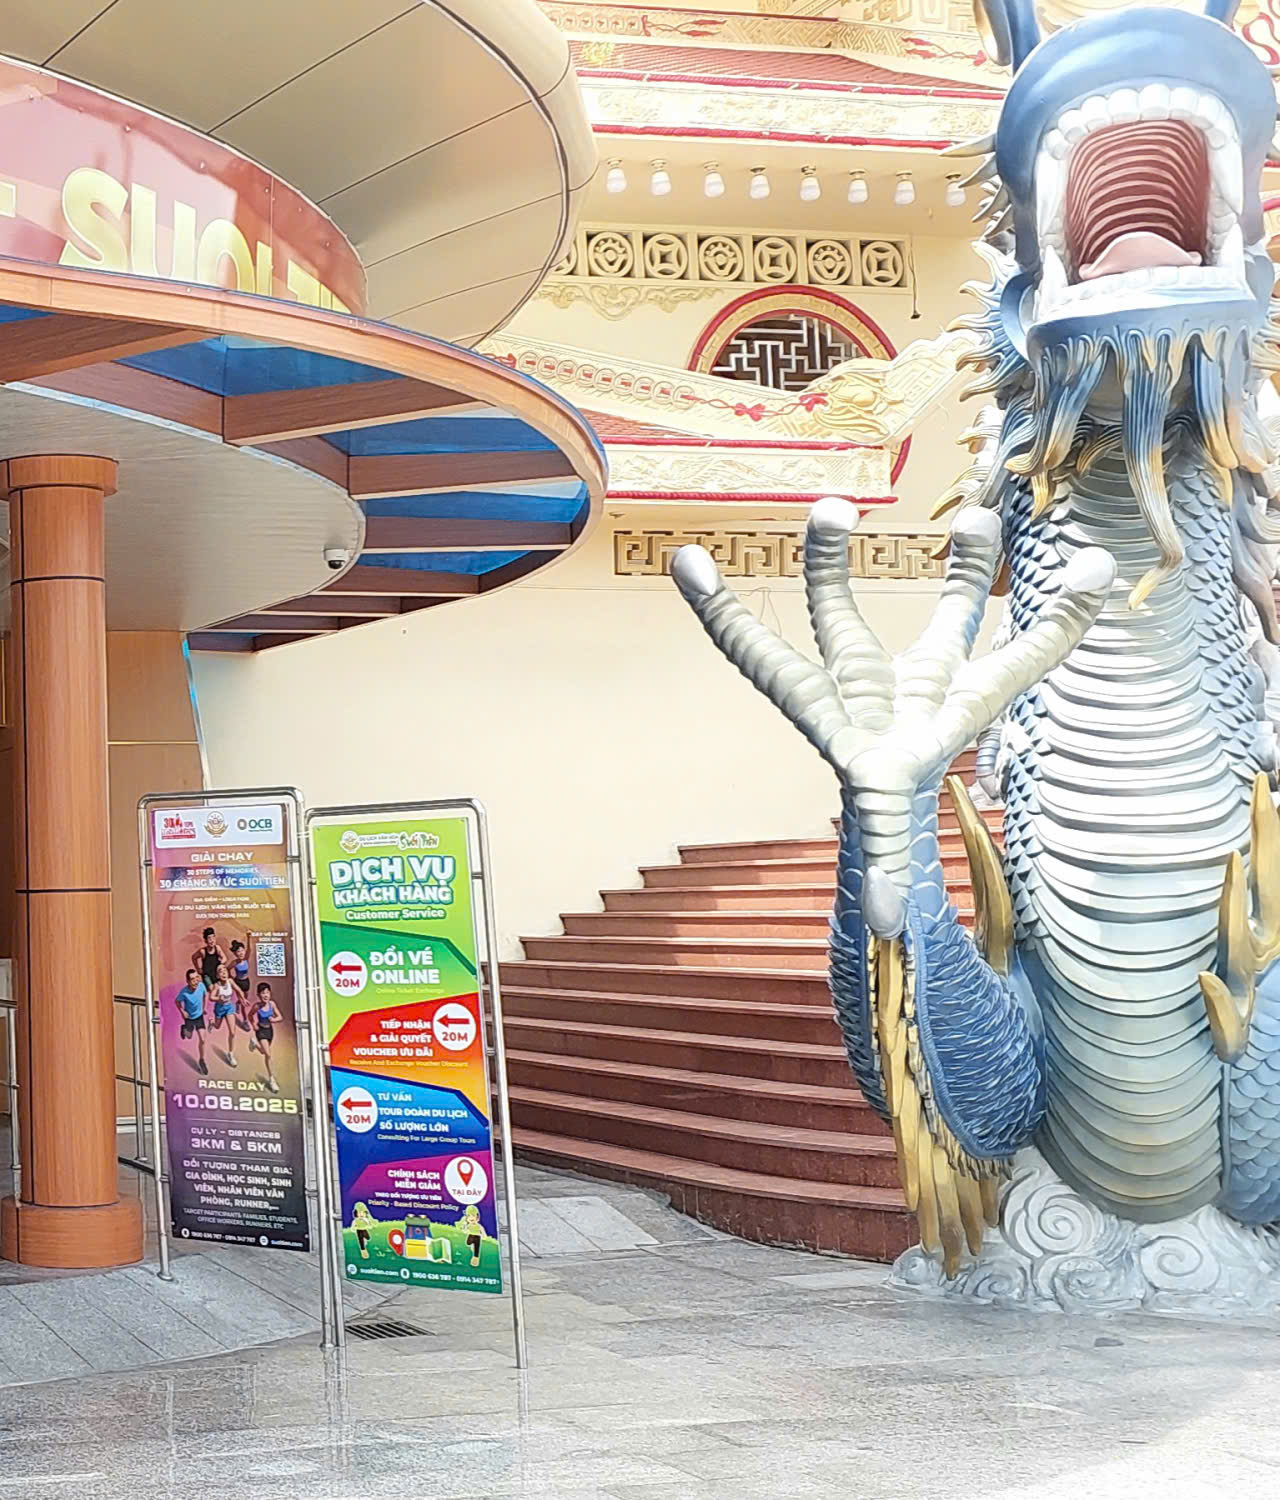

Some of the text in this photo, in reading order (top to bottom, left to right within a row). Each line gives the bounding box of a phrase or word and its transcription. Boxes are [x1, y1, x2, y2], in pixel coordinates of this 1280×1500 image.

[248, 818, 273, 829] OCB
[191, 851, 254, 863] GIẢI CHẠY
[329, 856, 455, 888] DỊCH VỤ
[159, 879, 172, 889] 30
[333, 881, 454, 908] KHÁCH HÀNG
[346, 906, 445, 920] Customer Service
[369, 945, 434, 966] ĐỔI VÉ
[335, 978, 360, 988] 20M
[371, 969, 440, 985] ONLINE
[380, 1018, 432, 1031] TIẾP NHẬN
[370, 1034, 378, 1043] &
[400, 1032, 432, 1044] QUYẾT
[441, 1031, 469, 1042] 20M
[352, 1047, 399, 1056] VOUCHER
[198, 1079, 266, 1092] RACE DAY
[391, 1091, 412, 1101] VẤN
[172, 1093, 298, 1114] 10.08.2025
[345, 1114, 371, 1124] 20M
[378, 1107, 403, 1116] TOUR
[431, 1109, 446, 1117] DU
[446, 1109, 468, 1120] LỊCH
[379, 1119, 393, 1130] SỐ
[394, 1121, 427, 1133] LƯỢNG
[190, 1127, 203, 1135] CỤ
[227, 1129, 281, 1139] DISTANCES
[191, 1138, 282, 1154] 3KM & 5KM
[239, 1163, 270, 1173] THAM
[185, 1171, 201, 1180] GIA
[226, 1174, 246, 1185] HỌC
[271, 1177, 292, 1188] SINH
[416, 1169, 440, 1180] SÁCH
[217, 1184, 242, 1195] NHÂN
[243, 1186, 265, 1197] VIÊN
[265, 1188, 285, 1199] VĂN
[451, 1188, 465, 1197] TẠI
